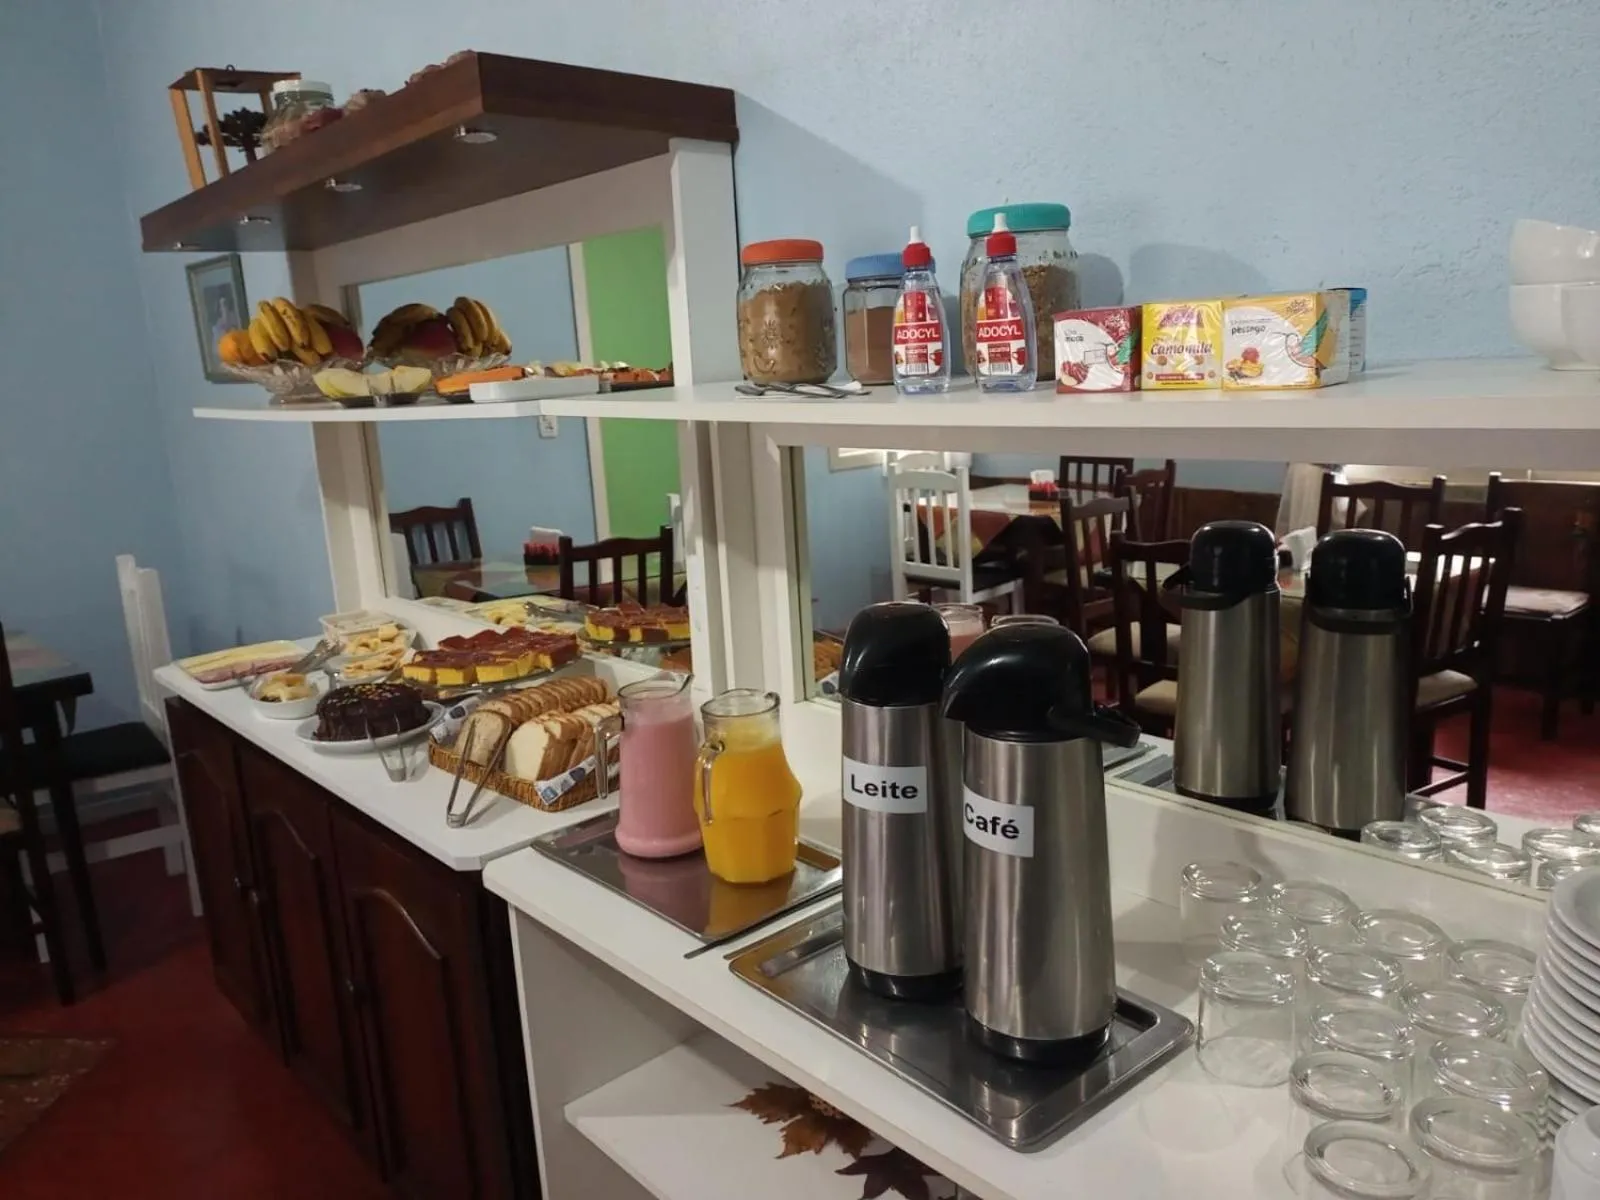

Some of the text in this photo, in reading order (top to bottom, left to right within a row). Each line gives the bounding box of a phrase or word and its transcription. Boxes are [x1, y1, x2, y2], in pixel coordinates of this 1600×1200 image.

[896, 327, 940, 341] ADOCYL
[978, 323, 1022, 338] ADOCYL
[850, 773, 919, 799] Leite
[964, 803, 1020, 839] Café
